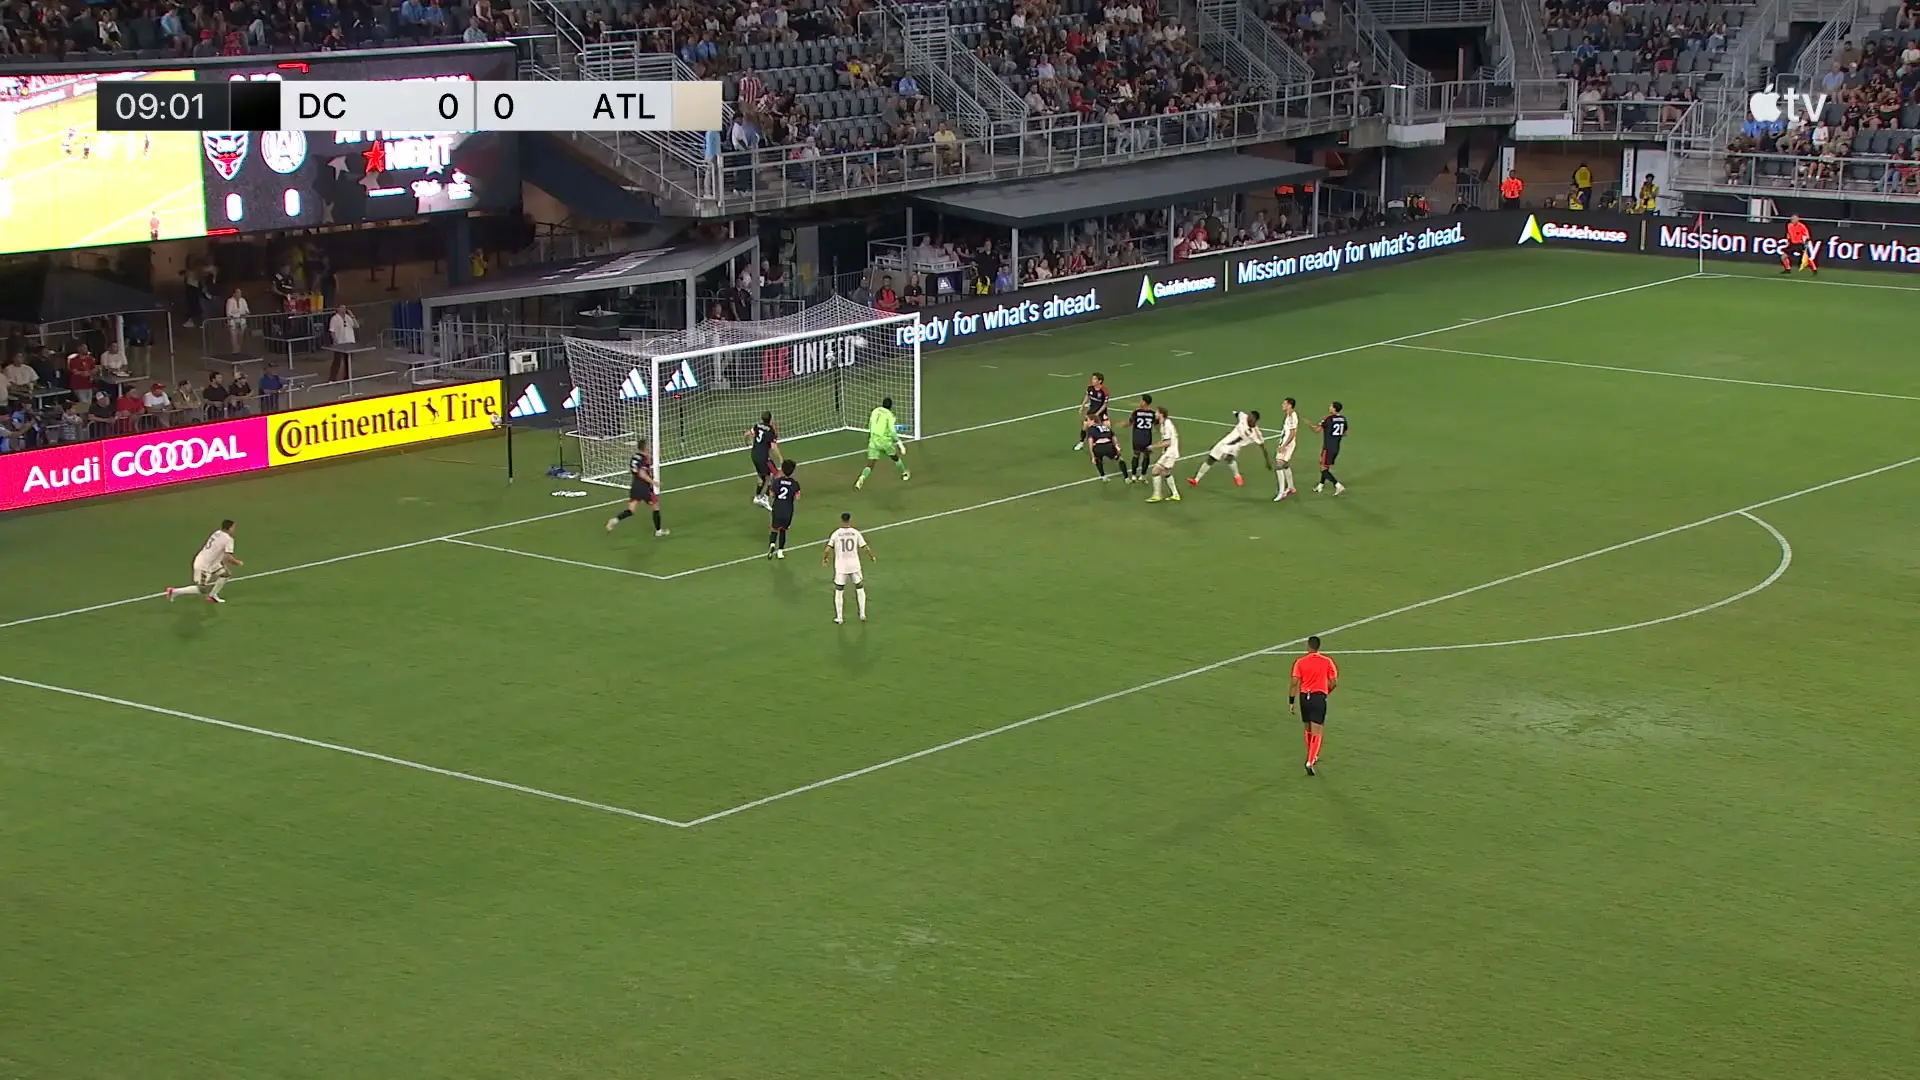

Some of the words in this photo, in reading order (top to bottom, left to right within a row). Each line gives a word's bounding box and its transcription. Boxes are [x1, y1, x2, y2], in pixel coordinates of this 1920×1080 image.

[1542, 222, 1627, 244] Guidehouse
[1660, 226, 1747, 253] Mission
[1753, 236, 1823, 261] reay
[1828, 235, 1864, 260] for
[1237, 255, 1297, 284] Mission
[1299, 247, 1342, 273] ready
[1344, 241, 1368, 265] for
[1368, 232, 1415, 260] what's
[1417, 222, 1465, 251] ahead.
[1153, 274, 1216, 298] Guidehouse
[952, 311, 981, 337] for
[982, 299, 1040, 330] what's
[1043, 288, 1100, 320] ahead.
[793, 336, 856, 375] UNITED
[276, 401, 418, 457] Continental
[441, 392, 496, 422] Tire
[1136, 417, 1153, 429] 23
[1332, 423, 1345, 436] 21
[756, 429, 764, 443] 3
[23, 456, 100, 492] Audi
[777, 486, 788, 500] 2
[840, 538, 855, 552] 10
